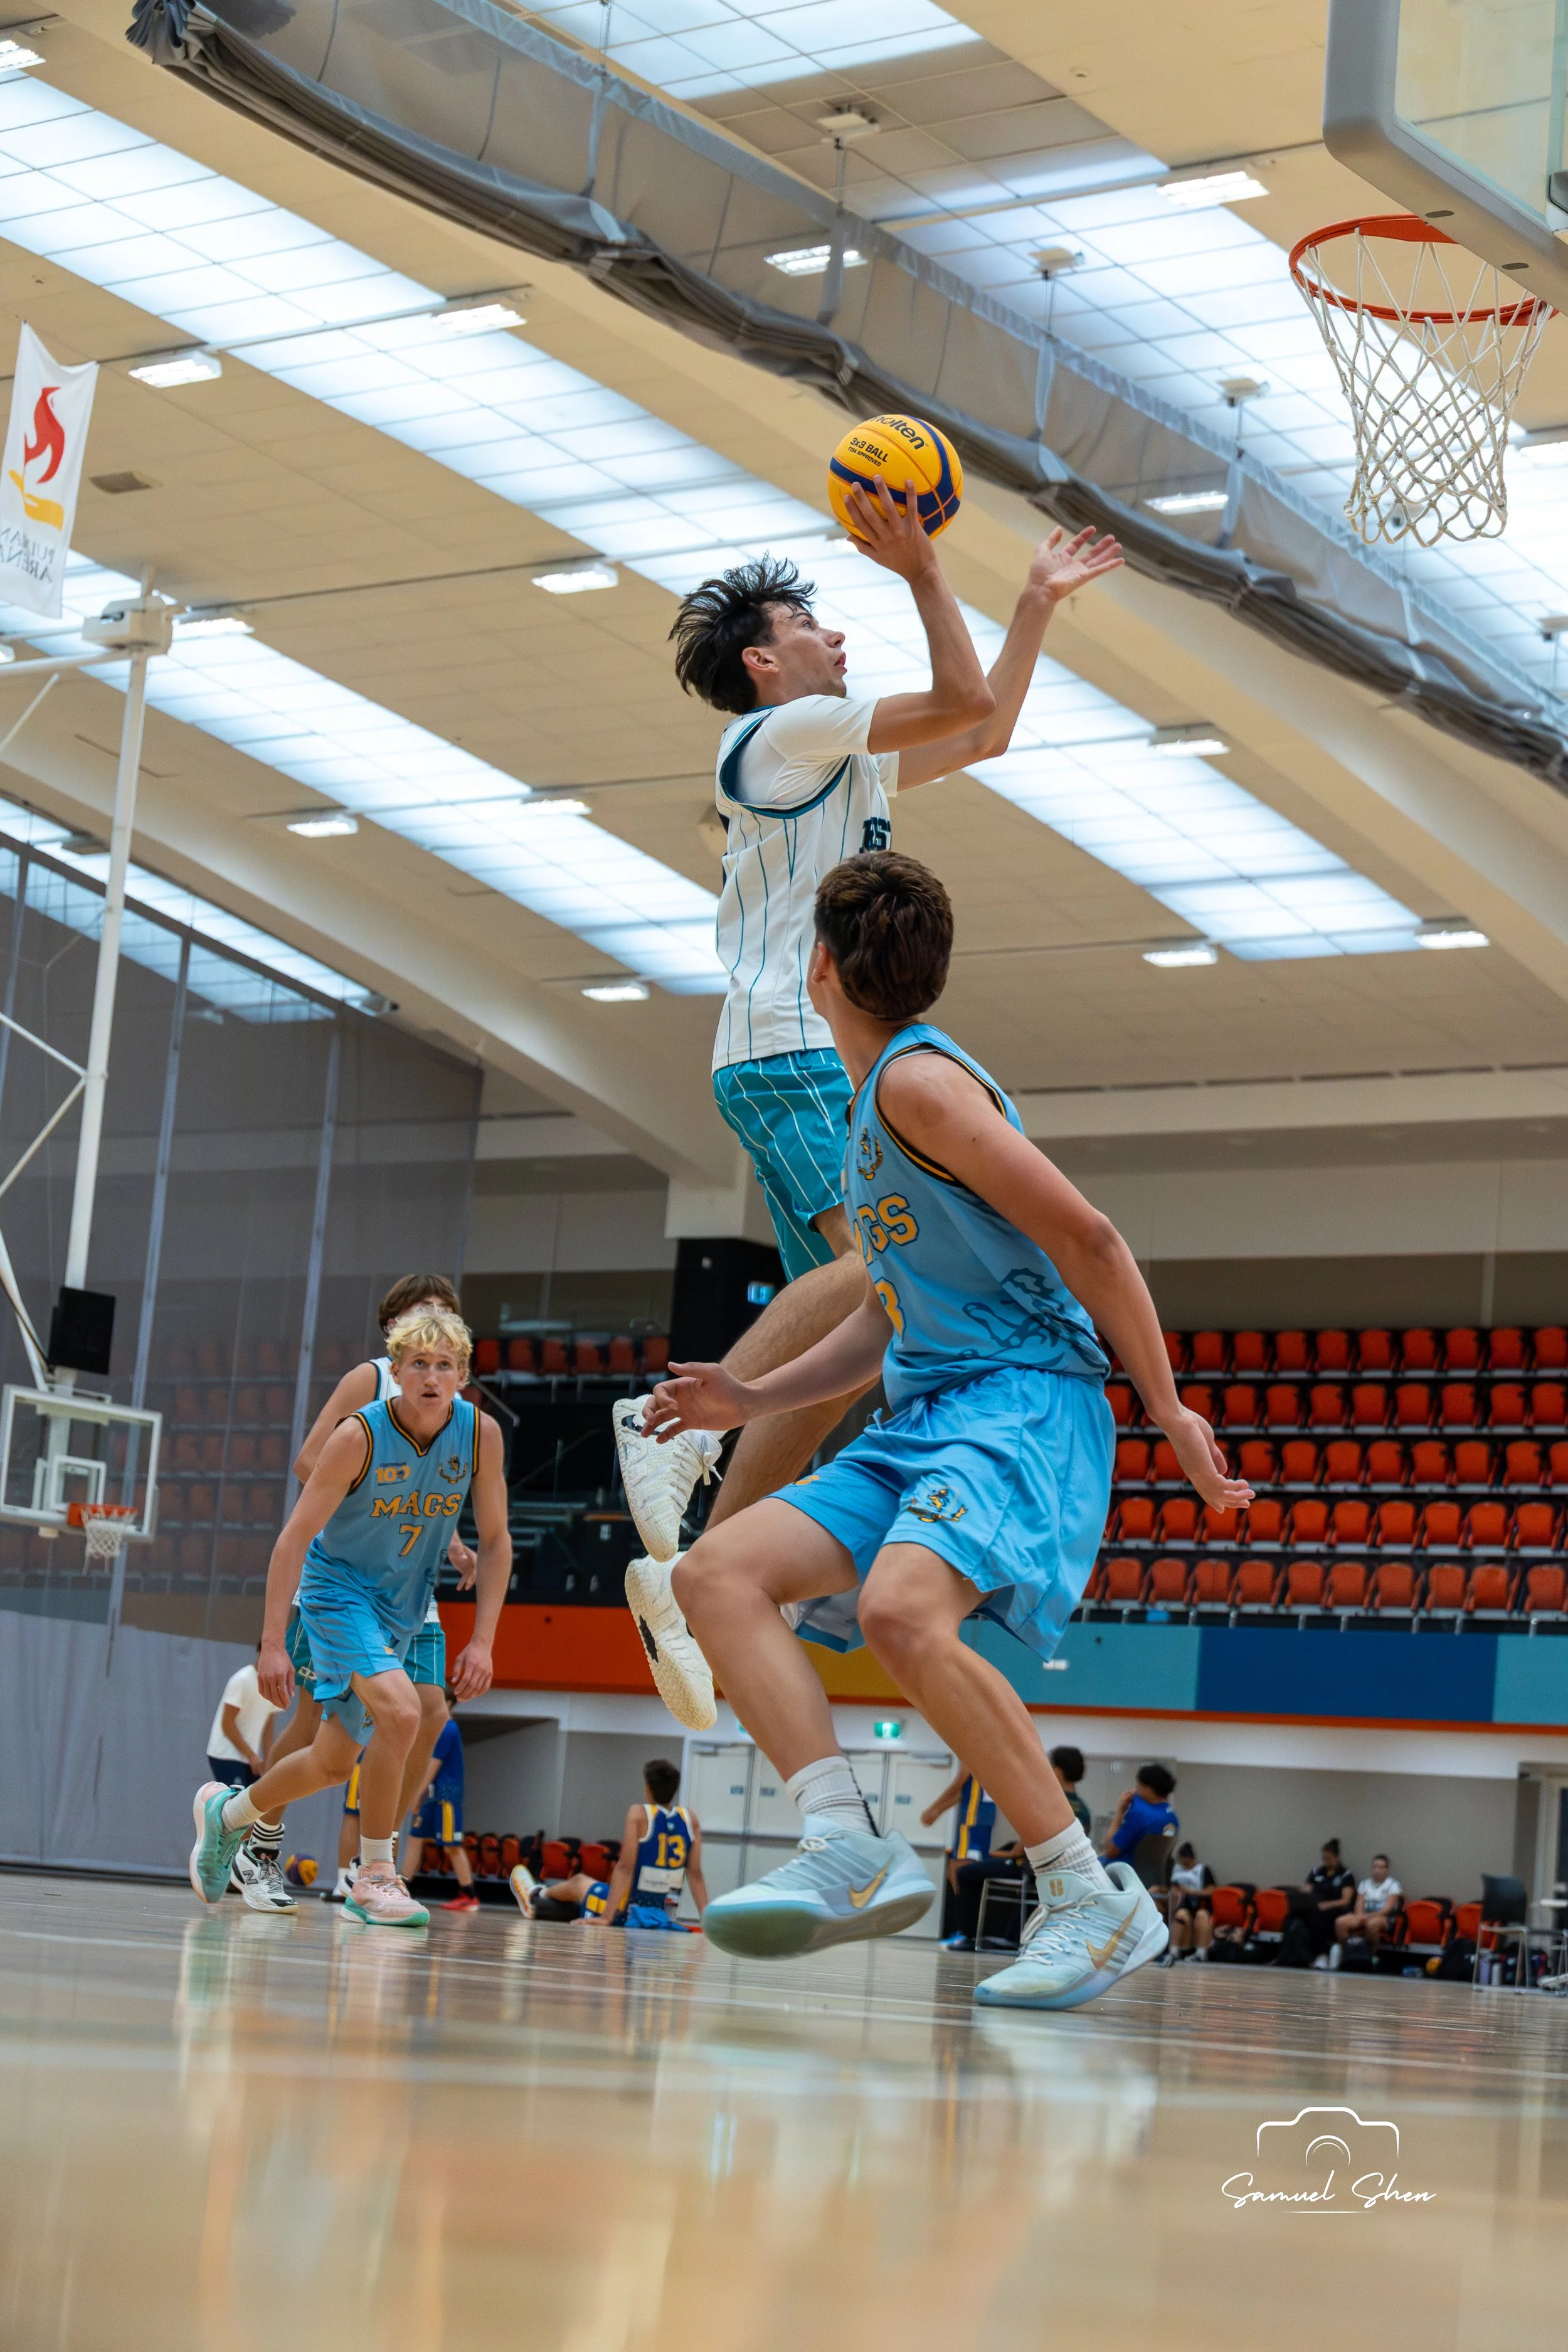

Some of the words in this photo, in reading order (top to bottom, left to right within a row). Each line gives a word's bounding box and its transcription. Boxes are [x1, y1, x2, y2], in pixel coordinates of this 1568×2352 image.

[857, 450, 882, 467] APPROVED
[866, 443, 888, 462] BALL
[369, 1489, 463, 1519] MAGS
[397, 1523, 424, 1557] 7
[654, 1832, 687, 1868] 13
